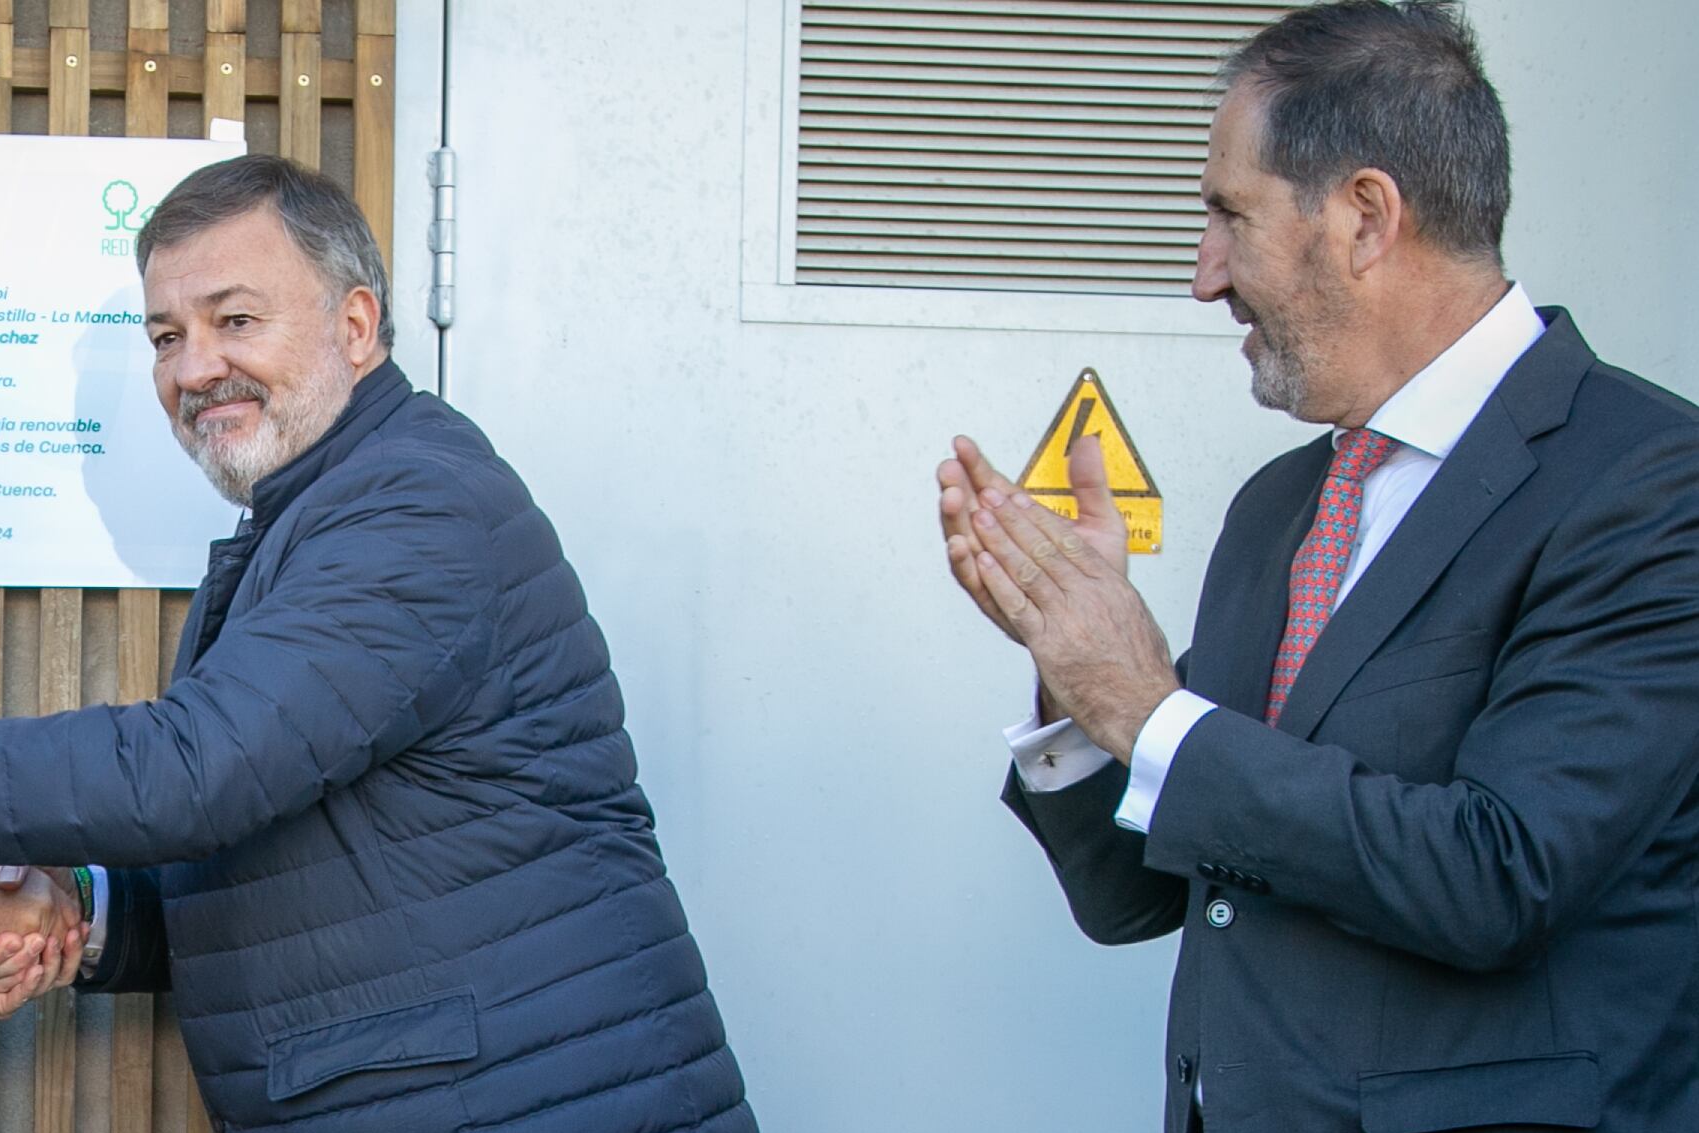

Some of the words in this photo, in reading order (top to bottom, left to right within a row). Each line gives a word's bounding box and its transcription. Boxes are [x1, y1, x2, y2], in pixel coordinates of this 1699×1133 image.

[101, 239, 129, 256] RED
[52, 310, 70, 324] La
[19, 418, 102, 432] renovable
[14, 439, 35, 453] de
[39, 440, 106, 454] Cuenca.
